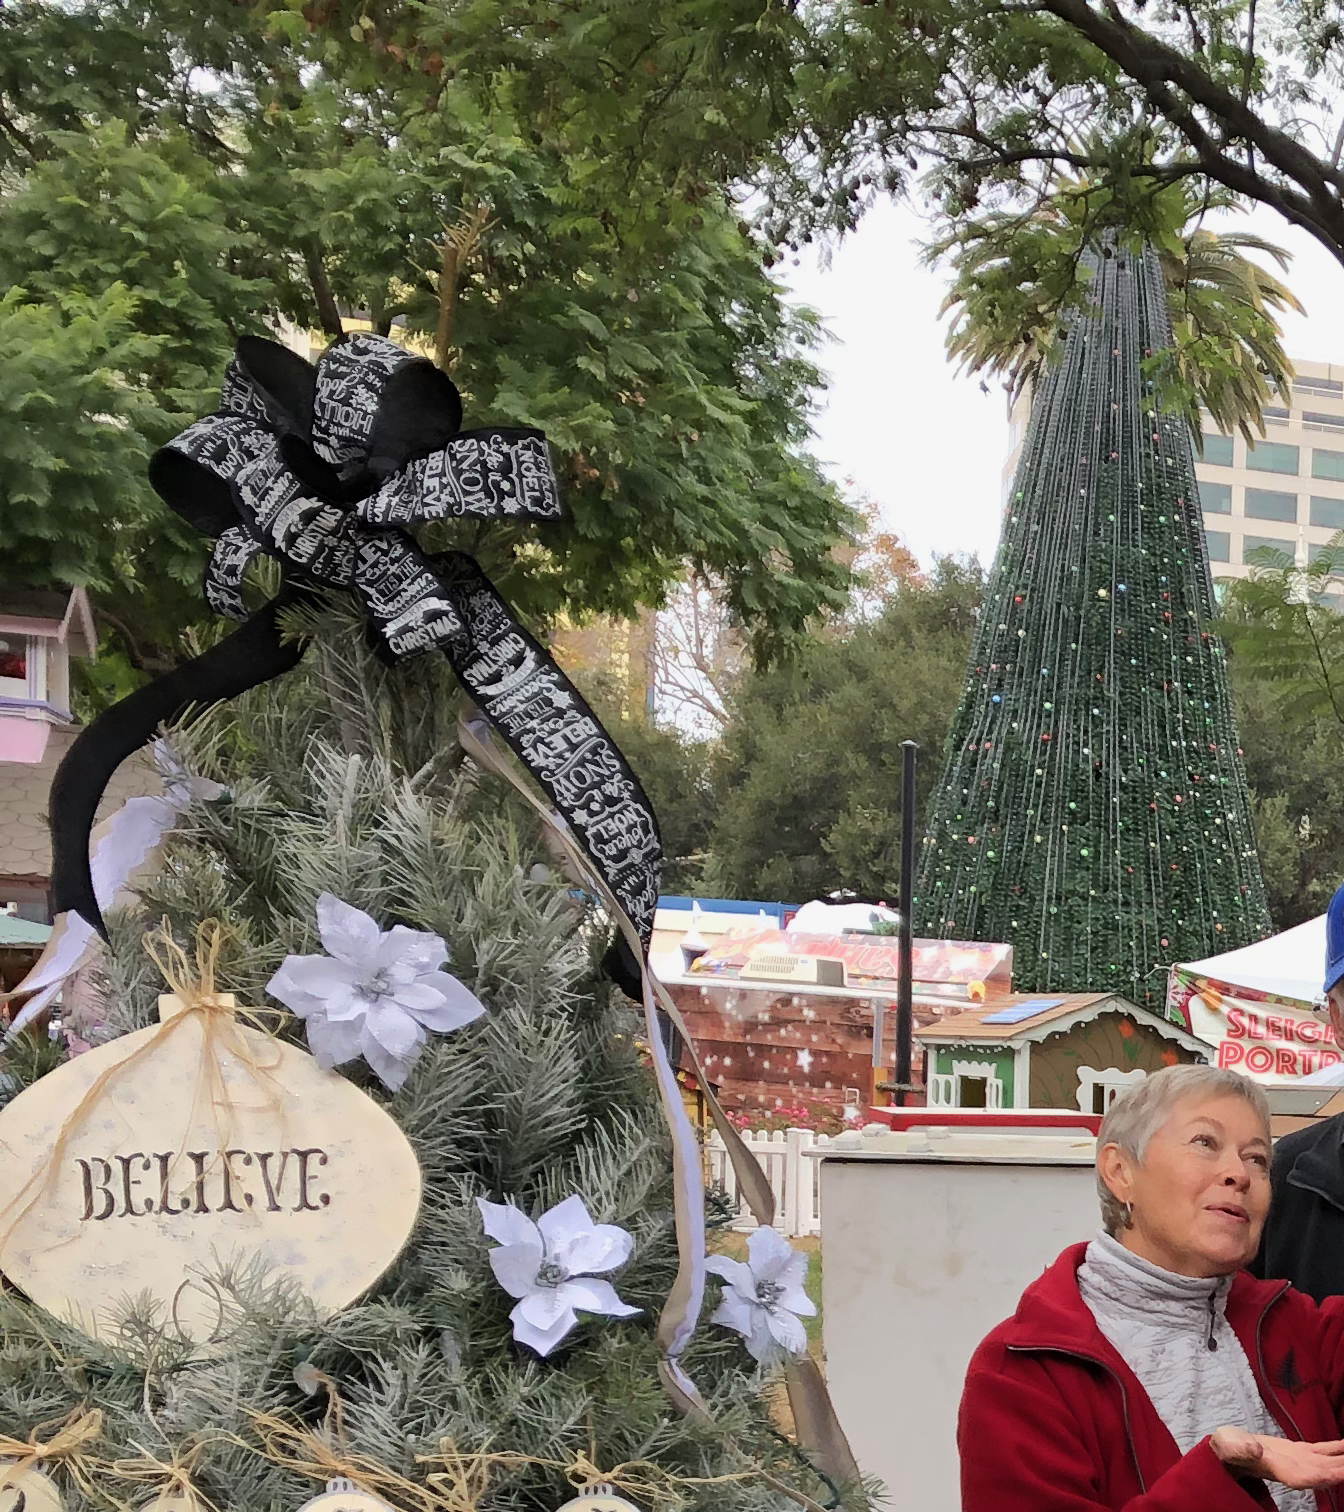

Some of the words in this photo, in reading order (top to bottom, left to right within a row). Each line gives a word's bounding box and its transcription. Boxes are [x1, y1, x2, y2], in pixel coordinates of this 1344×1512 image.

[455, 438, 488, 516] SNOW
[518, 449, 541, 504] NOEL
[288, 505, 344, 563] CHRISTMAS
[388, 612, 461, 654] CHRISTMAS
[463, 632, 526, 687] CHRISTMAS
[551, 750, 620, 802] SNOW
[600, 806, 639, 839] NOEL
[75, 1148, 331, 1221] BELIEVE
